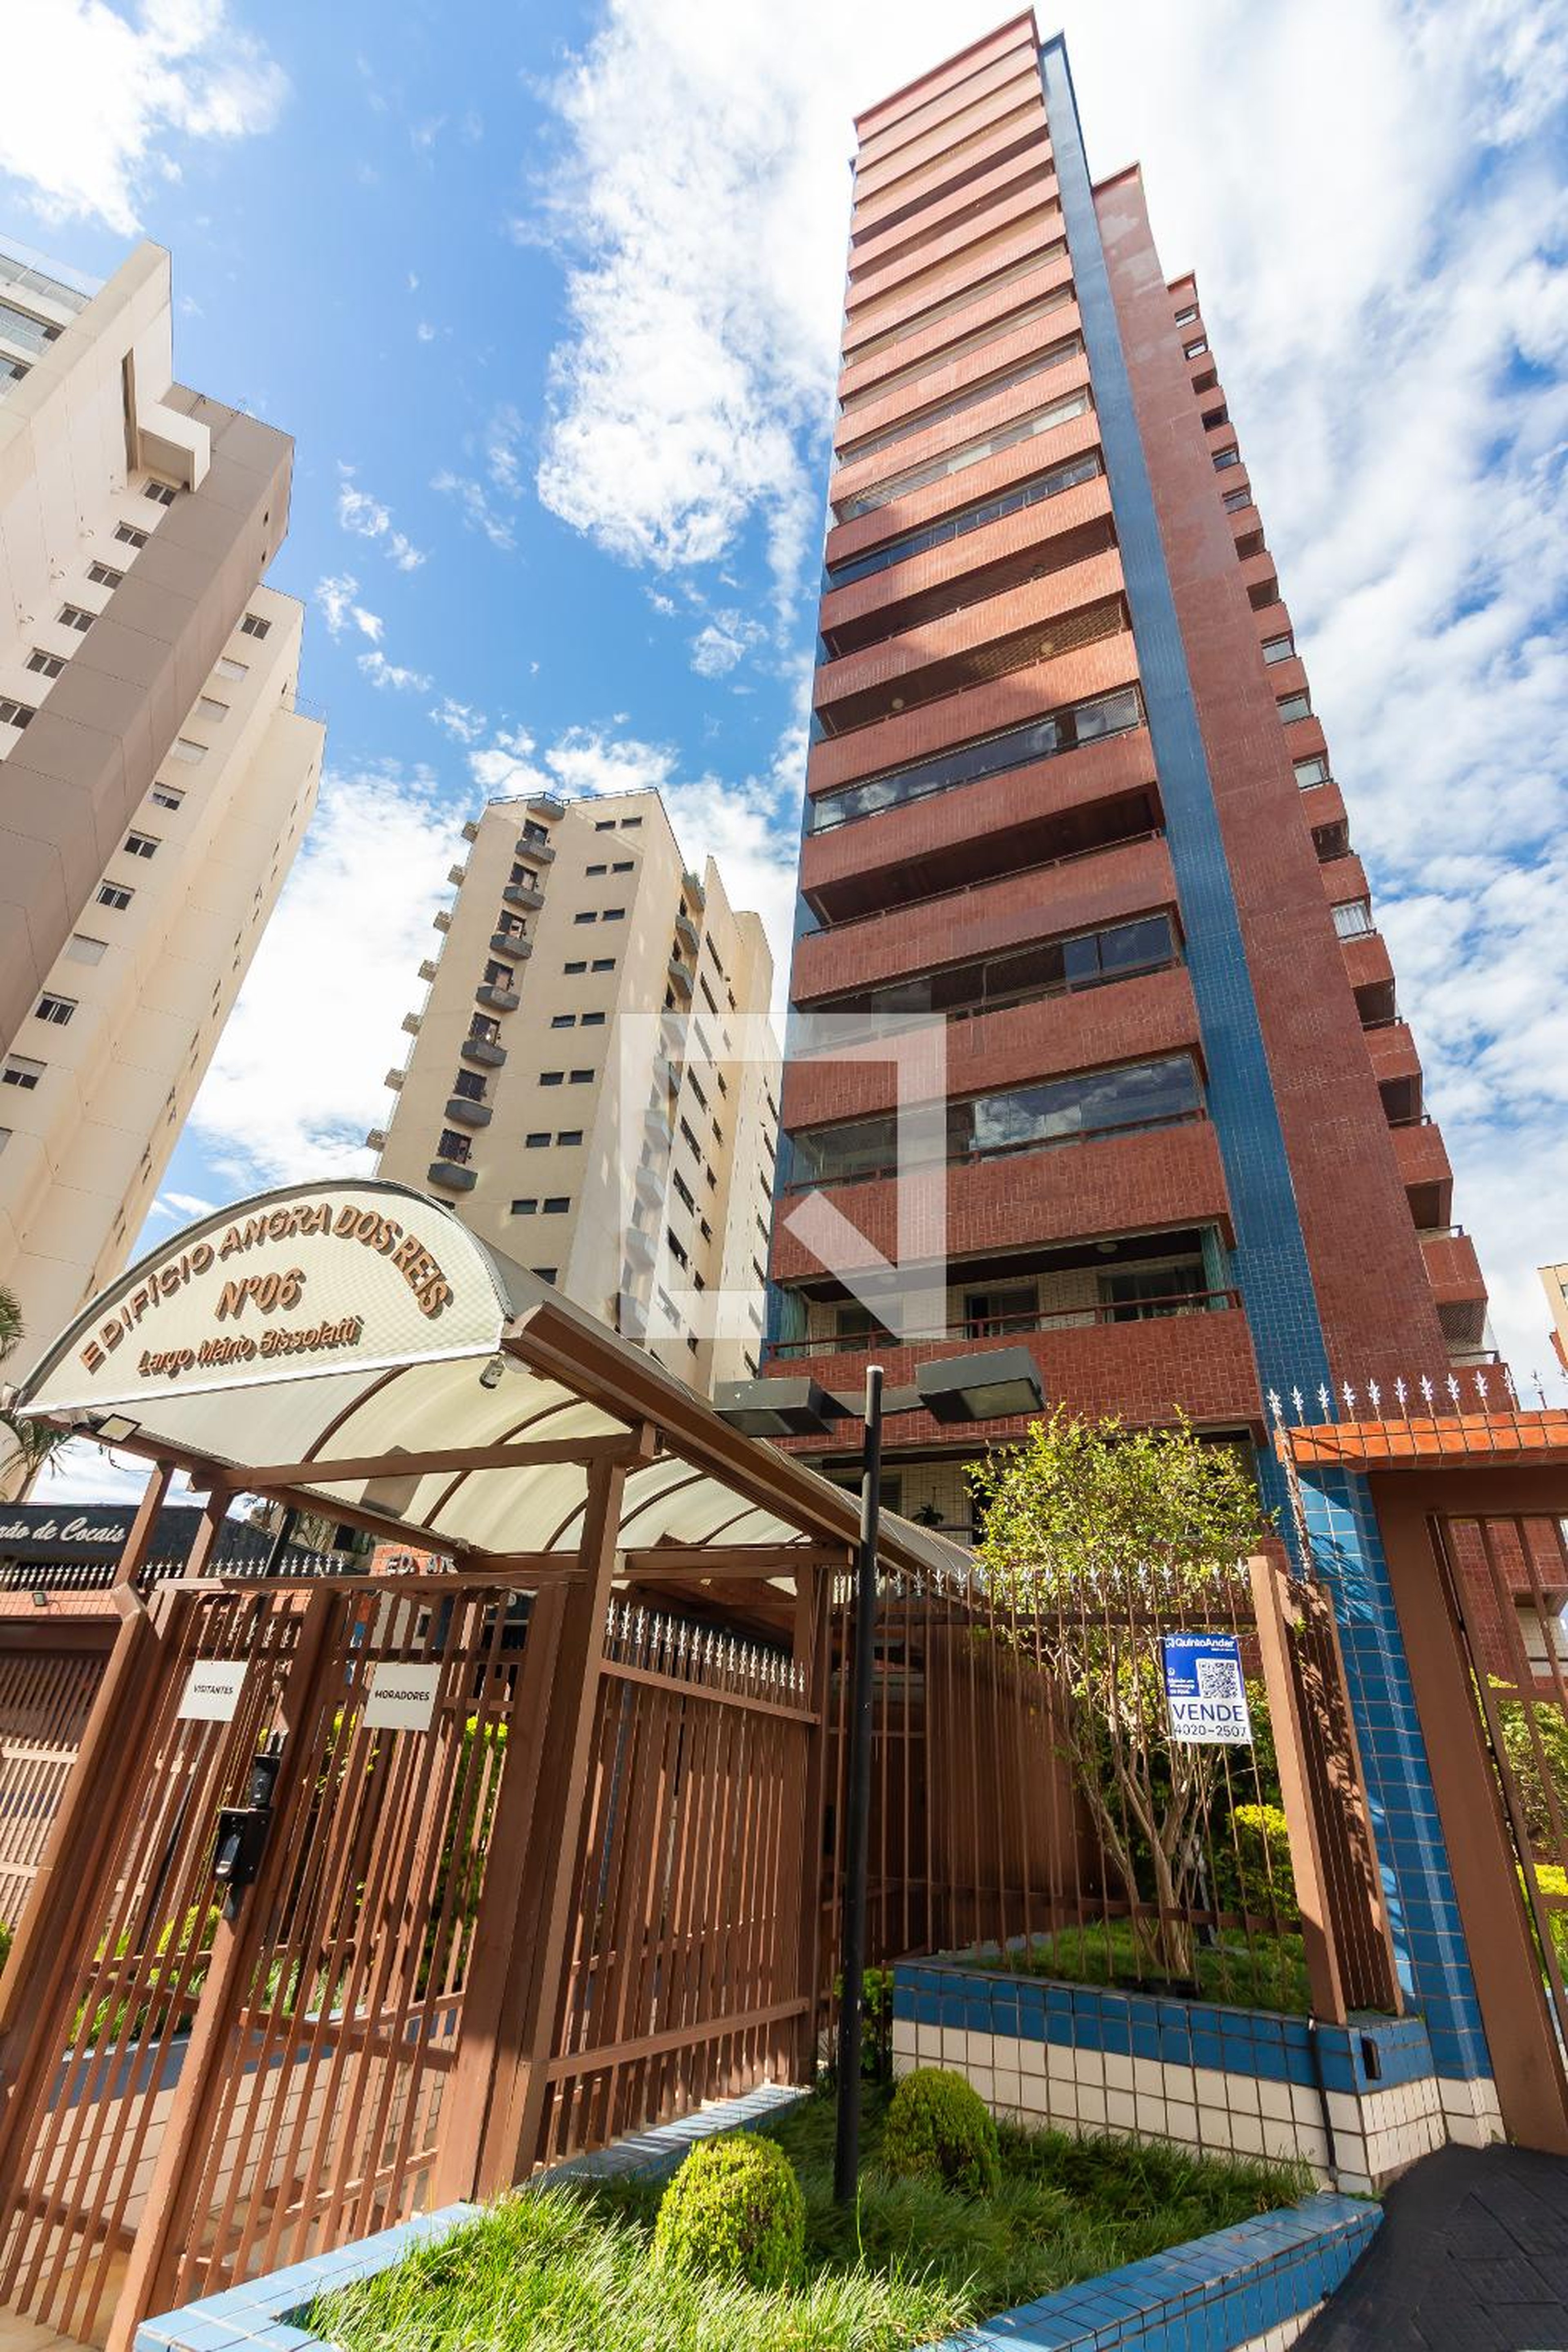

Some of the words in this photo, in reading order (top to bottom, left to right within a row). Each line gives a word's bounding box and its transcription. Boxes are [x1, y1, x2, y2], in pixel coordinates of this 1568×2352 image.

[218, 1203, 331, 1260] ANGRA
[332, 1205, 403, 1255] DOS
[390, 1234, 454, 1320] REIS
[137, 1350, 195, 1379] Largo
[260, 1316, 361, 1356] Bissolatti
[32, 1519, 58, 1541] de
[60, 1517, 125, 1542] Cocais
[1175, 1638, 1235, 1648] QuintoAndar
[194, 1685, 233, 1694] VISITANTES
[374, 1690, 430, 1701] MORADORES
[1172, 1704, 1244, 1722] VENDE
[1174, 1724, 1246, 1737] 4020-2507
